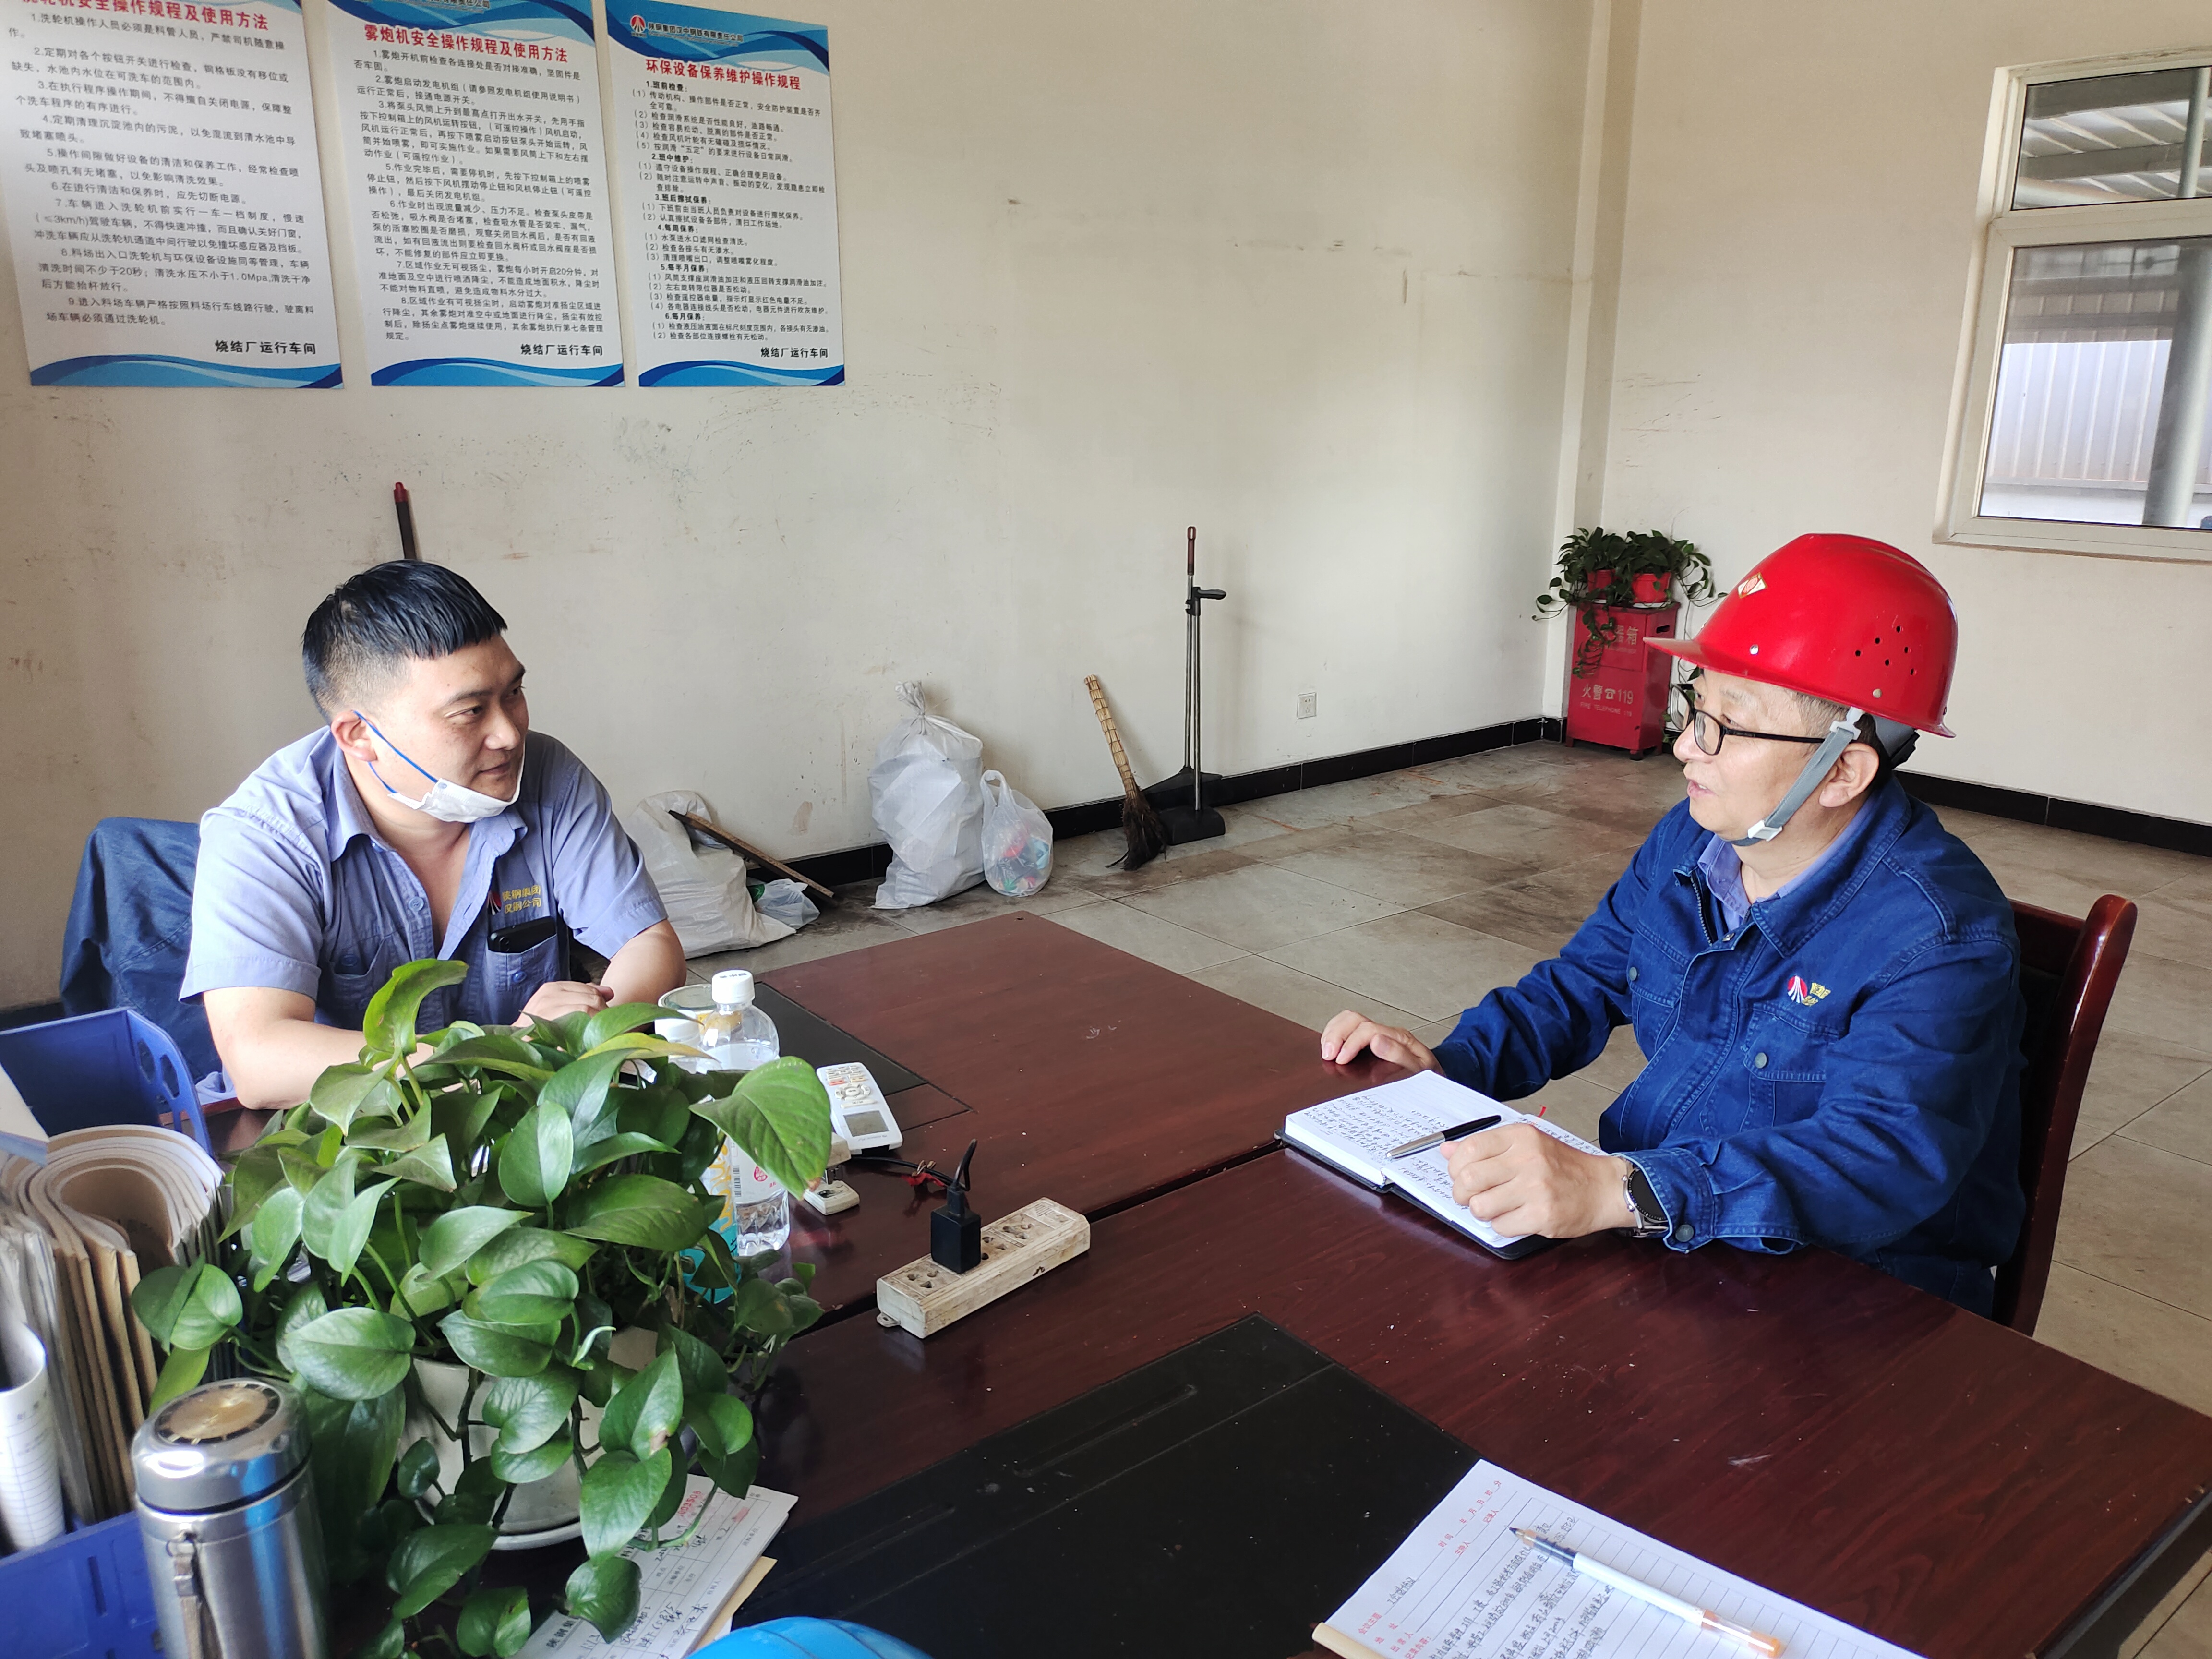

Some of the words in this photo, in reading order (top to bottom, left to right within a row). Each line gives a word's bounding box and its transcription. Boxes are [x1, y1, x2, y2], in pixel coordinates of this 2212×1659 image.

[365, 24, 568, 62] 雾炮机安全操作规程及使用方法
[646, 59, 801, 90] 环保设备保养维护操作规程
[215, 340, 317, 355] 烧结厂运行车间
[520, 344, 603, 355] 烧结厂运行车间
[761, 347, 828, 358] 烧结厂运行车间
[1581, 683, 1603, 700] 火警
[1618, 688, 1633, 704] 119
[502, 885, 541, 902] 陕钢集团
